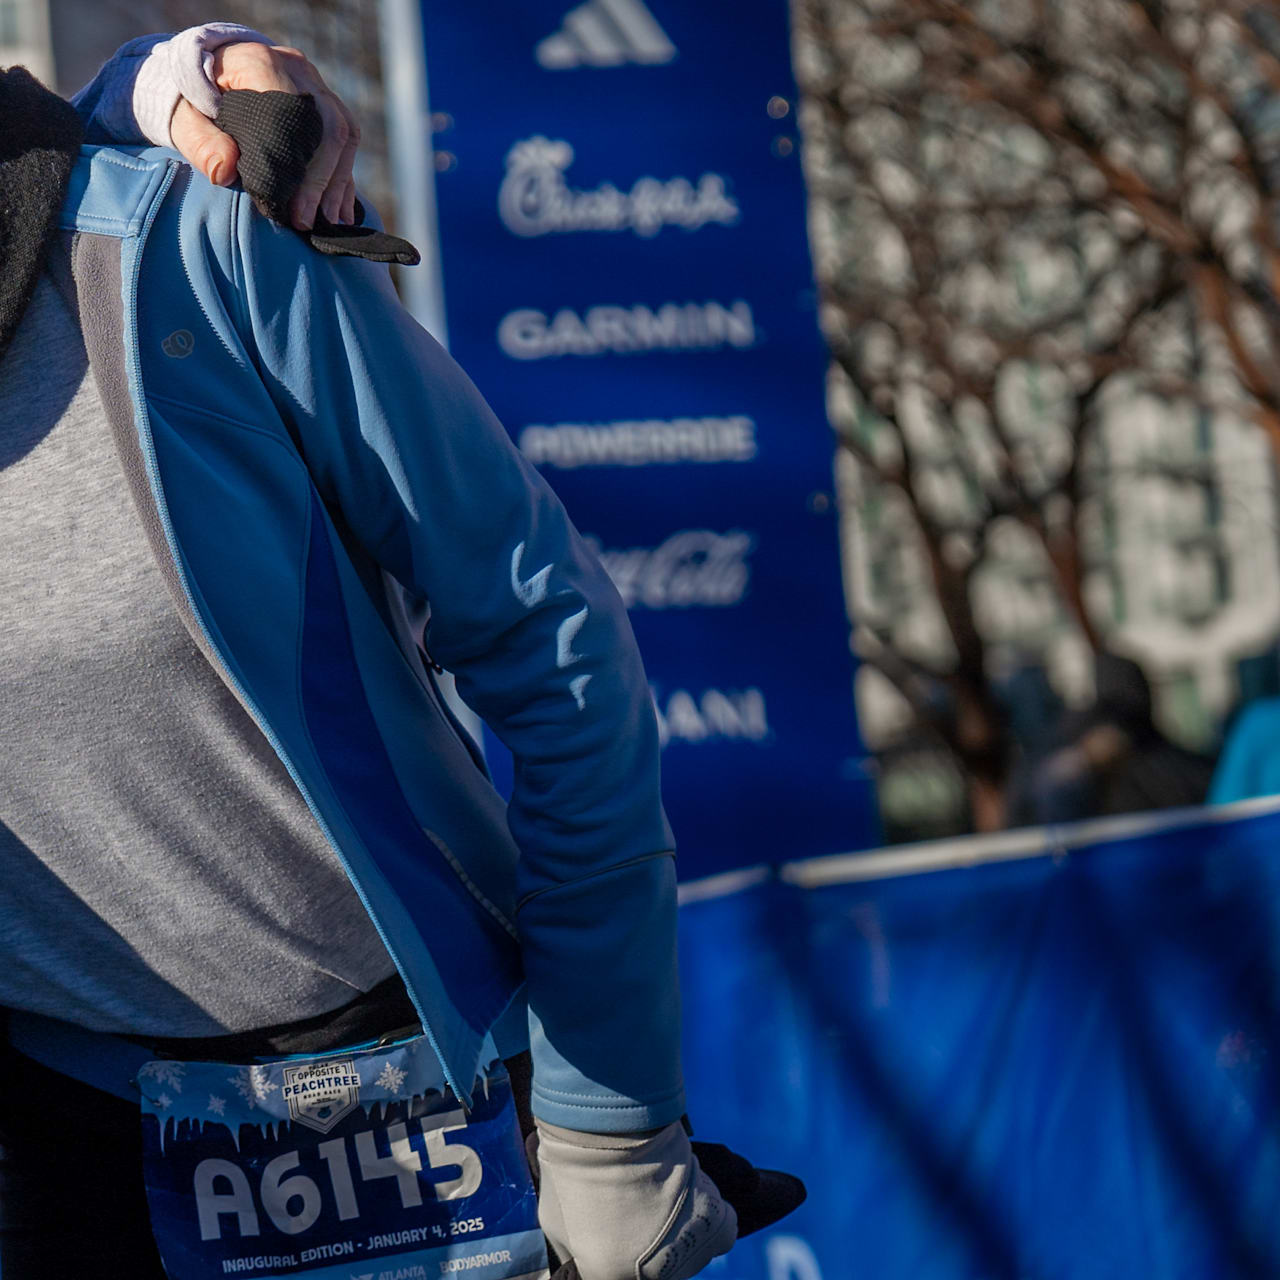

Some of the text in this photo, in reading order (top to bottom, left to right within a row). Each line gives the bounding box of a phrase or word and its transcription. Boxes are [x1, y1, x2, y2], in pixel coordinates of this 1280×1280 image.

[498, 301, 755, 360] GARMIN
[298, 1065, 340, 1080] OPPOSITE
[284, 1075, 358, 1097] PEACHTREE
[193, 1109, 483, 1241] A6145
[222, 1255, 298, 1273] INAUGURAL
[300, 1241, 354, 1263] EDITION
[367, 1227, 428, 1250] JANUARY
[432, 1224, 446, 1238] 4,
[450, 1217, 484, 1235] 2025
[377, 1266, 427, 1280] ATLANTA
[440, 1250, 511, 1273] BODYARMOR
